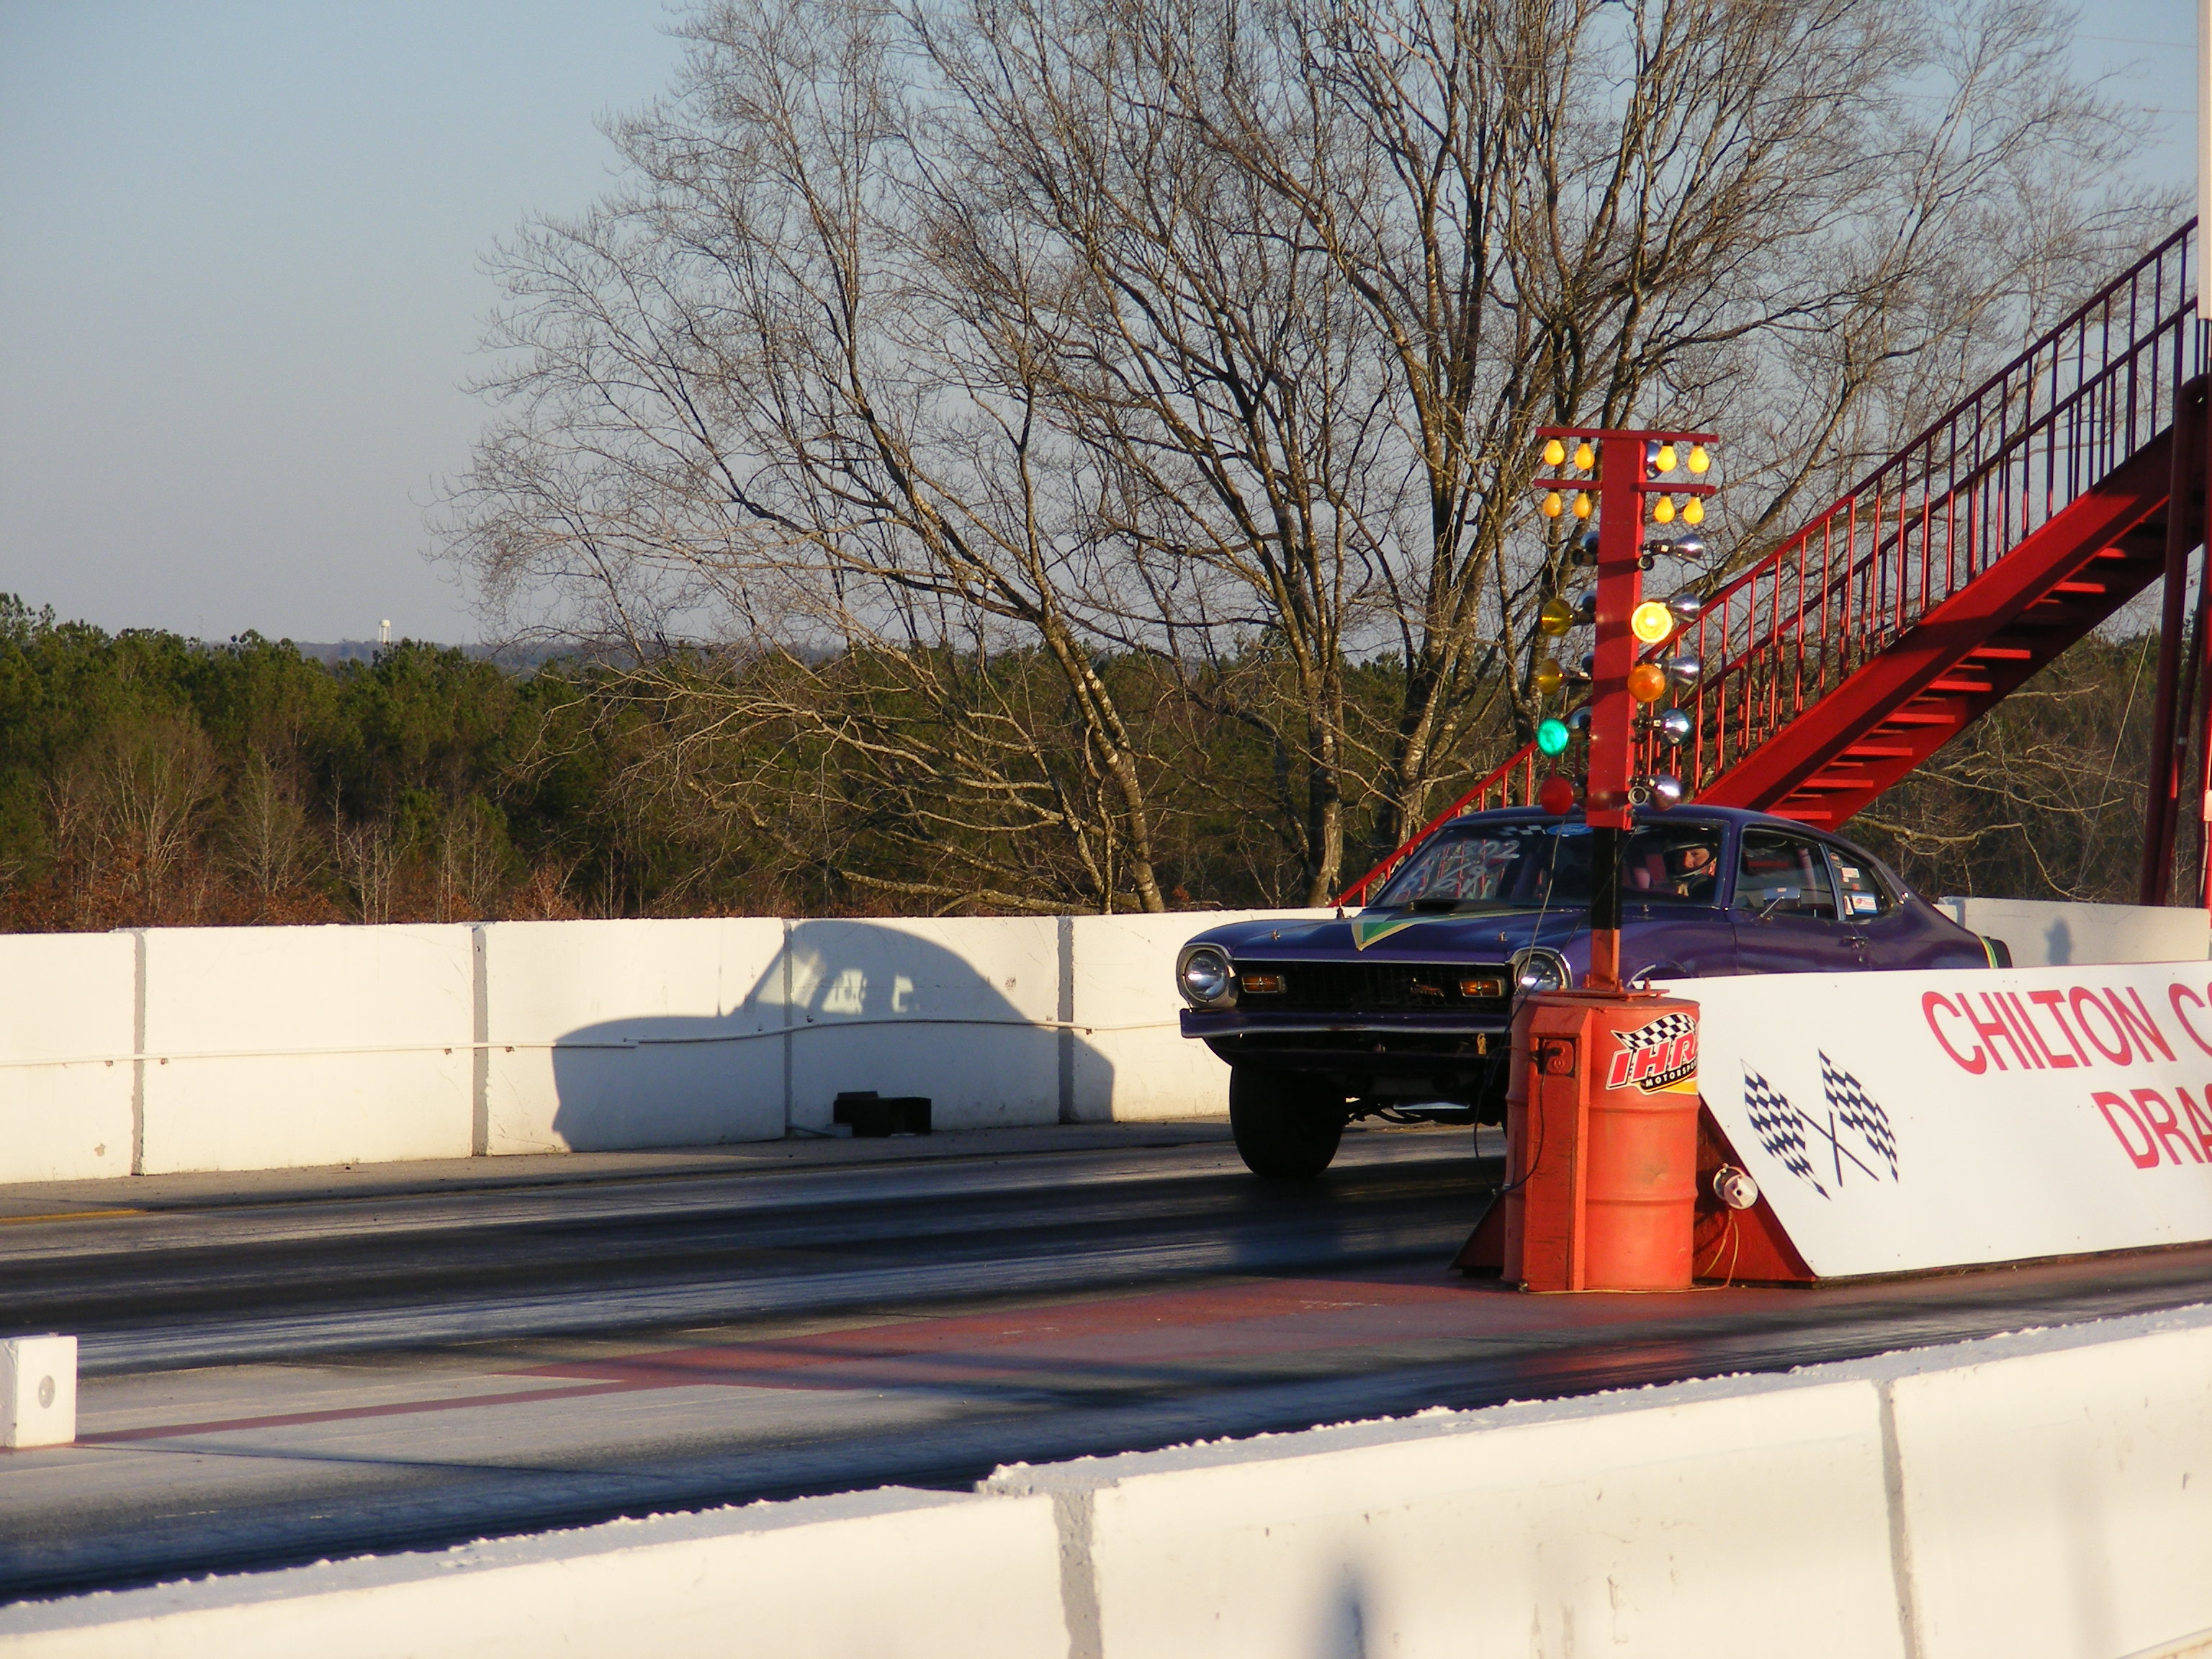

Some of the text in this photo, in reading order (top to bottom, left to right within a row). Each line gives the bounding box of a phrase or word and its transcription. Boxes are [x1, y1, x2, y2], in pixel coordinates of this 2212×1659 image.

[1606, 1031, 1698, 1088] IHR
[1922, 981, 2212, 1074] CHILTON C
[2091, 1083, 2212, 1169] DRA
